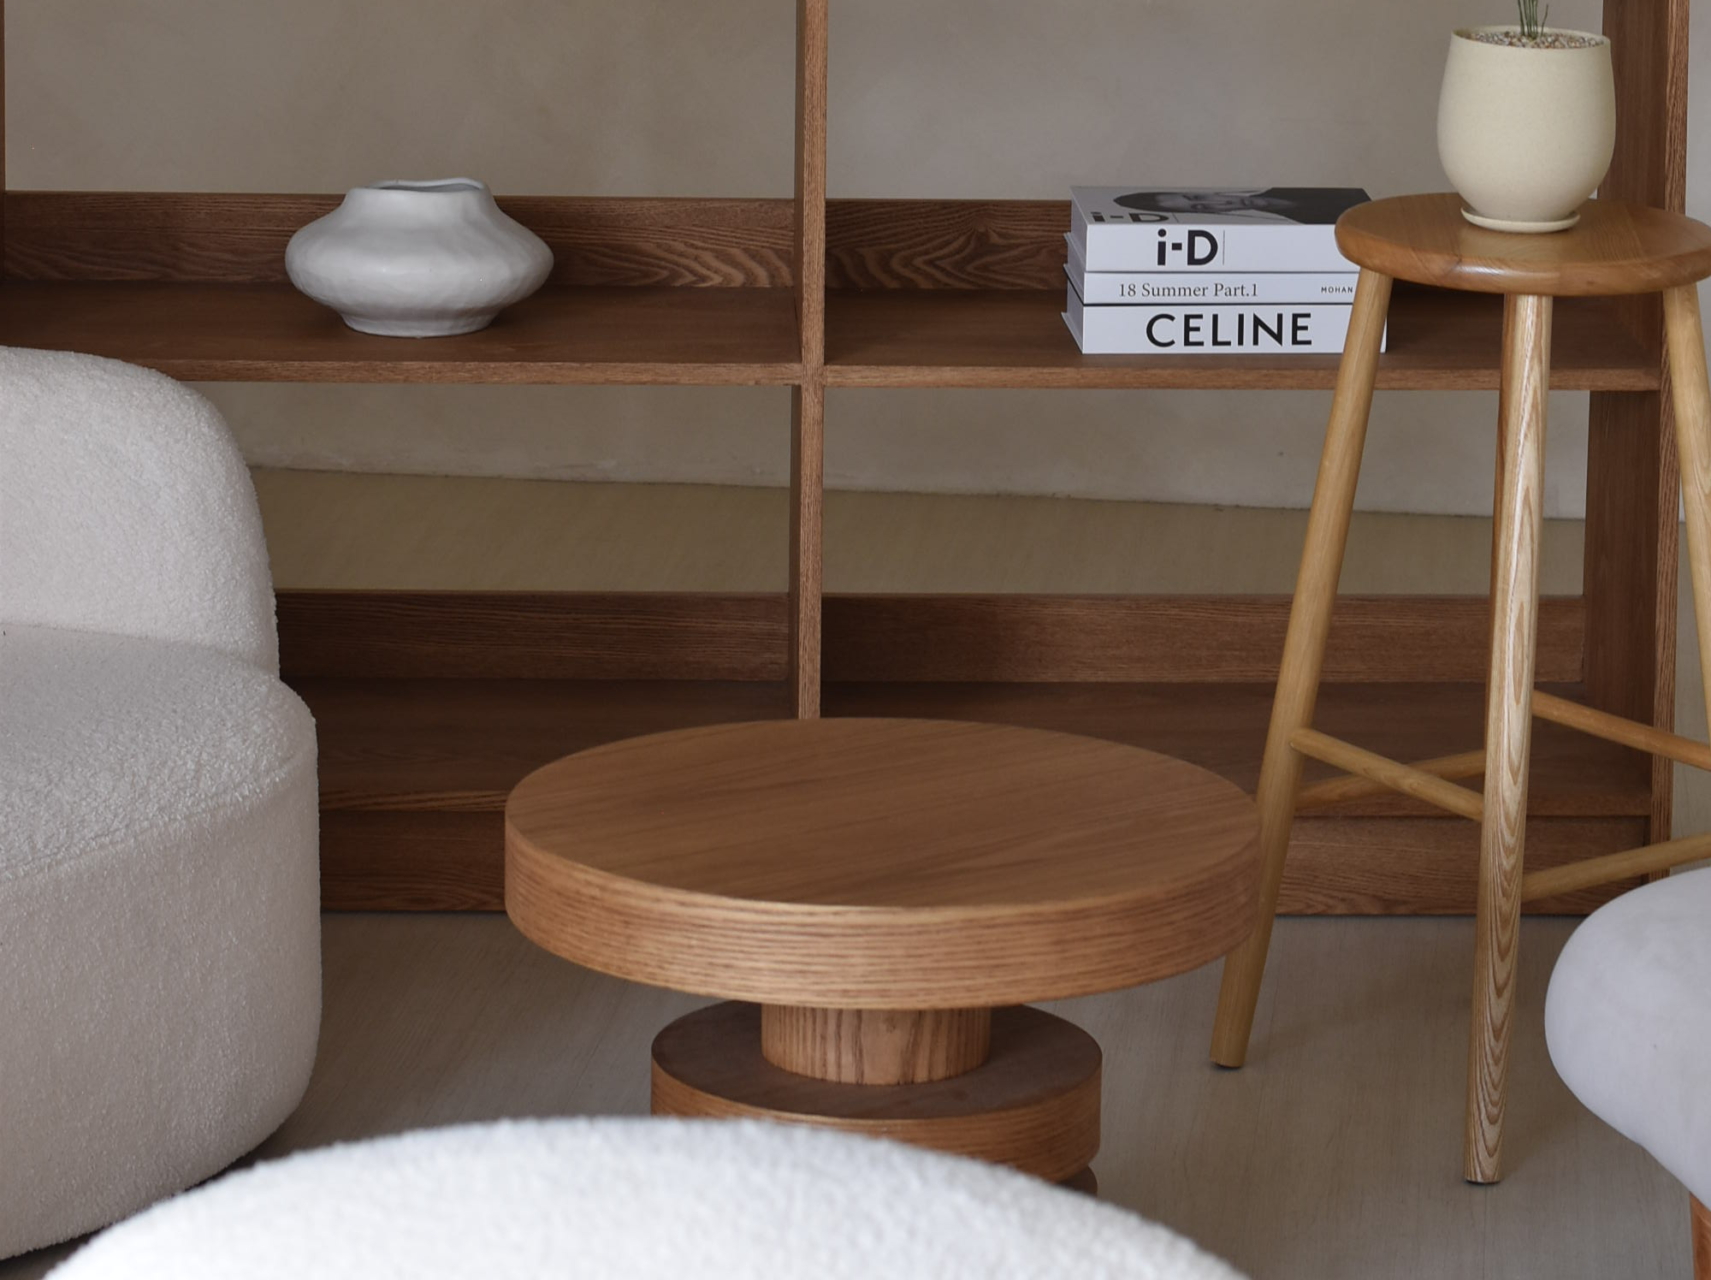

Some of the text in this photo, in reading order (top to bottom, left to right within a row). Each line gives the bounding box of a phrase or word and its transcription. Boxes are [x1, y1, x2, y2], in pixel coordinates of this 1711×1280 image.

[1090, 211, 1170, 223] i-D
[1157, 228, 1219, 266] i-D
[1119, 282, 1259, 297] 18 Summer Part.1
[1145, 312, 1313, 348] CELINE
